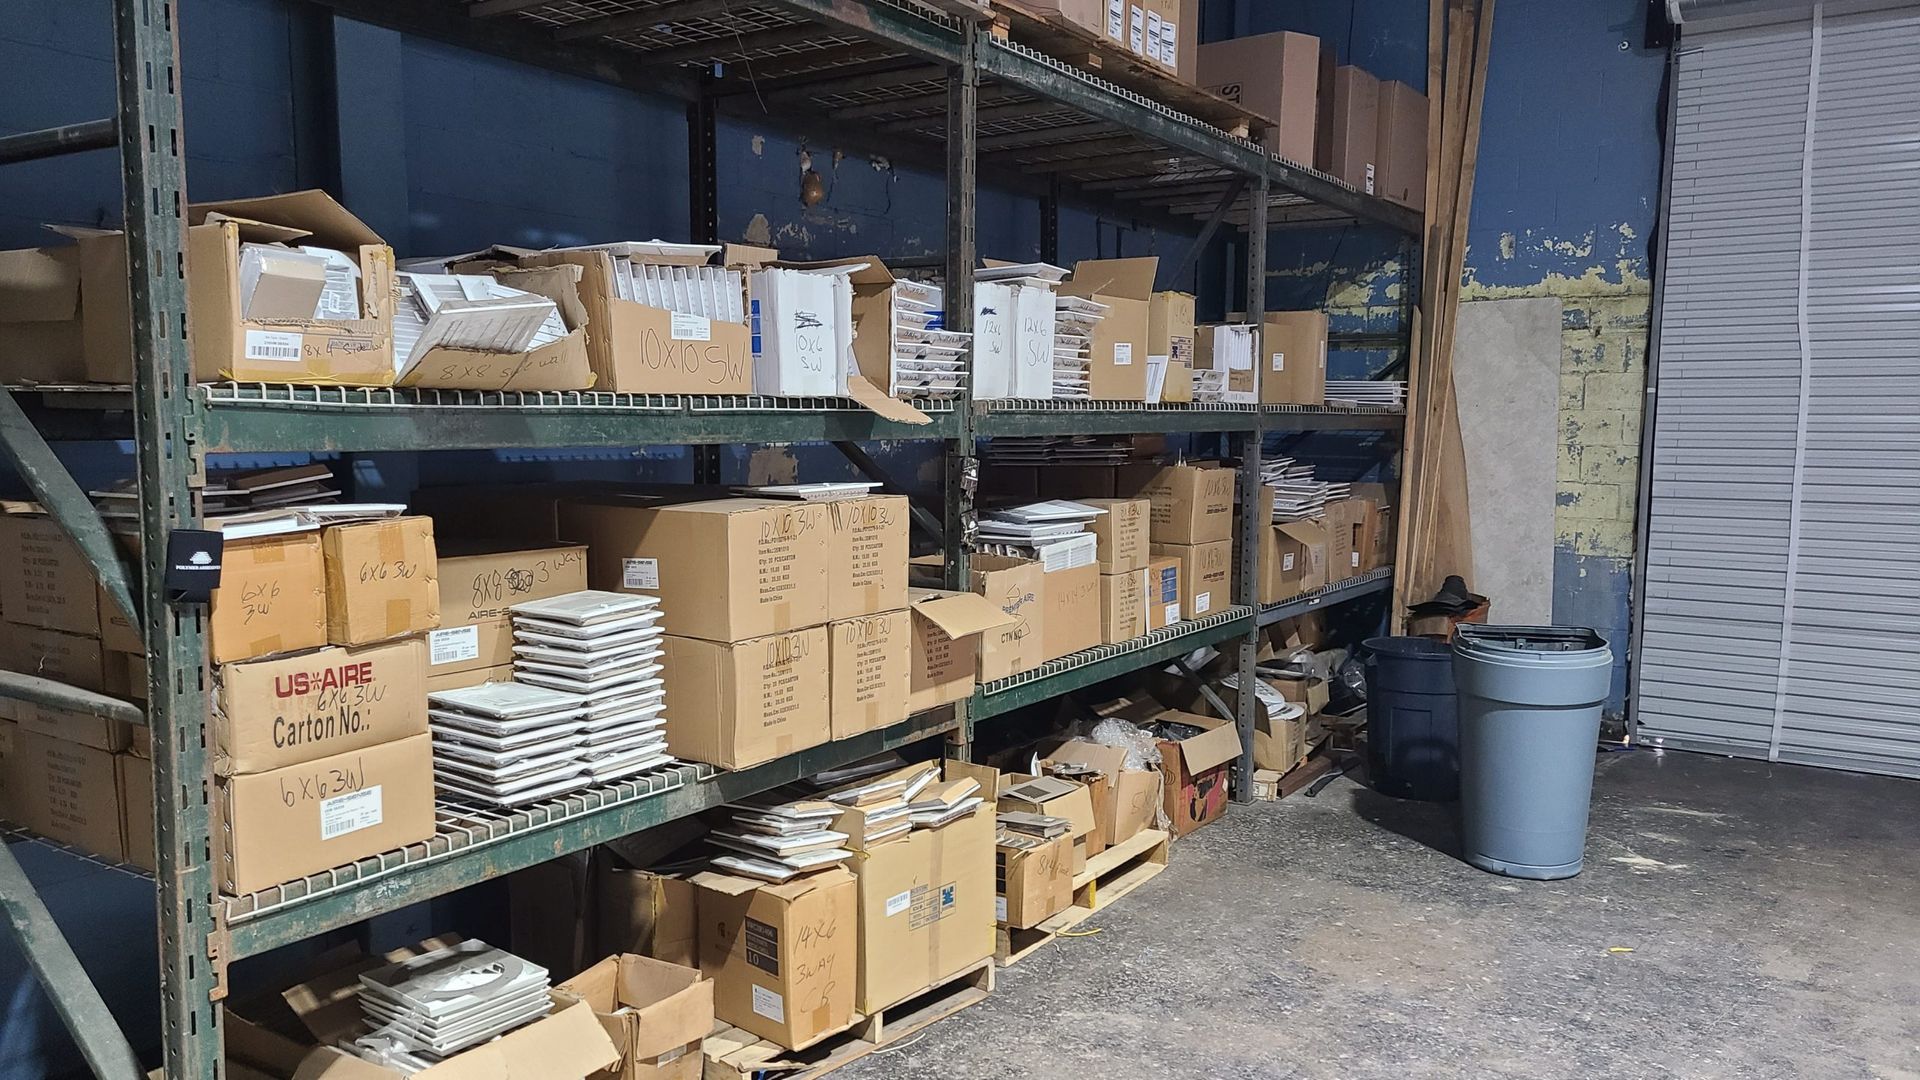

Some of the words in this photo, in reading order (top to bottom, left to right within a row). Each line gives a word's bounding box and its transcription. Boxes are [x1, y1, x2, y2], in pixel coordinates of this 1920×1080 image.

[1024, 318, 1047, 337] 12X6
[796, 335, 823, 353] 10X6
[1028, 339, 1050, 367] SW
[440, 364, 491, 381] 8X8
[704, 341, 746, 385] SW
[801, 356, 822, 372] SW
[761, 513, 792, 539] 10X10
[794, 508, 816, 535] 3W
[847, 504, 878, 529] 10X10
[360, 561, 387, 584] 6X6
[393, 560, 417, 579] 3W
[472, 570, 502, 608] 8X8
[535, 560, 550, 583] 3
[241, 580, 280, 603] 6X6
[468, 607, 512, 620] AIRE-S
[846, 621, 873, 645] 10X10
[1001, 631, 1013, 643] CTN
[766, 637, 791, 665] 10X10
[317, 686, 347, 711] 6X6
[273, 713, 335, 748] Carton
[280, 773, 328, 807] 6X6
[329, 757, 365, 793] 3W
[747, 951, 760, 966] 10
